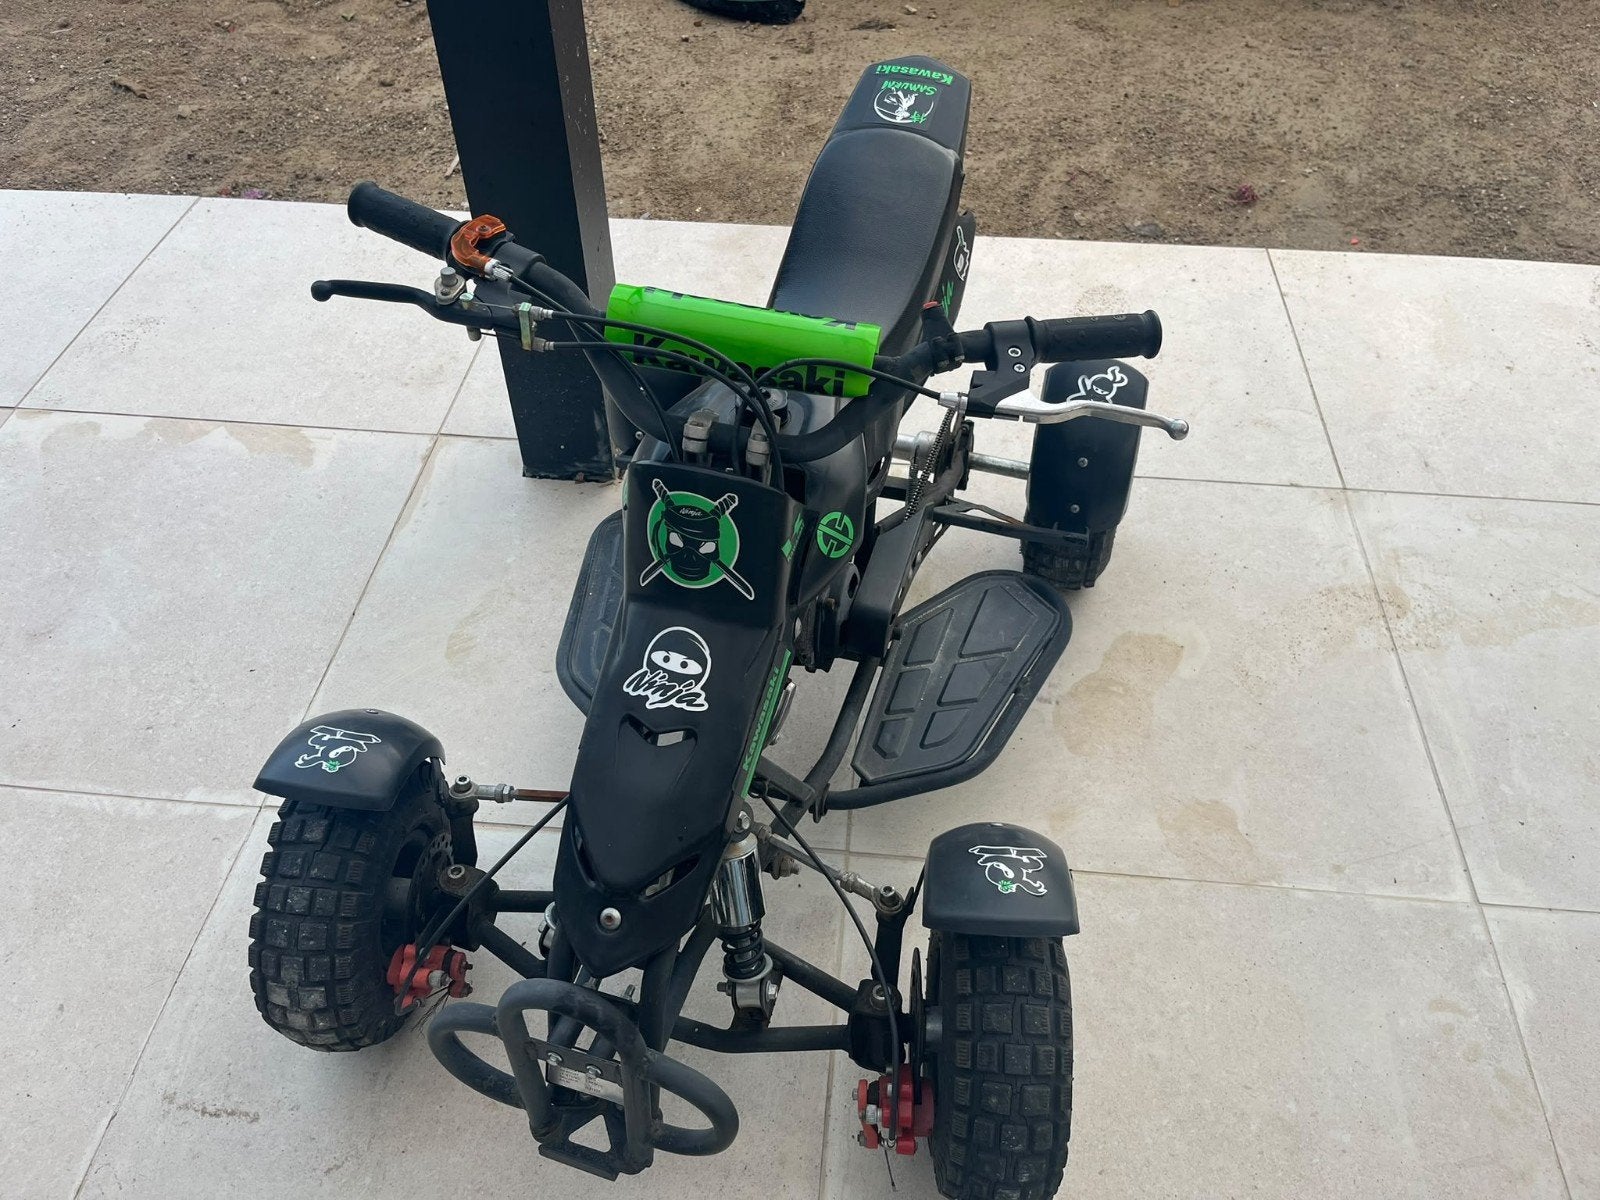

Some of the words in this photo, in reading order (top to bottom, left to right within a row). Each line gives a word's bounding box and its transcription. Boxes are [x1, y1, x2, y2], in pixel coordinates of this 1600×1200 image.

[875, 65, 953, 85] Kawasaki
[882, 80, 937, 96] SAMURAI
[623, 669, 709, 711] Ninja
[743, 667, 780, 772] Kawasaki
